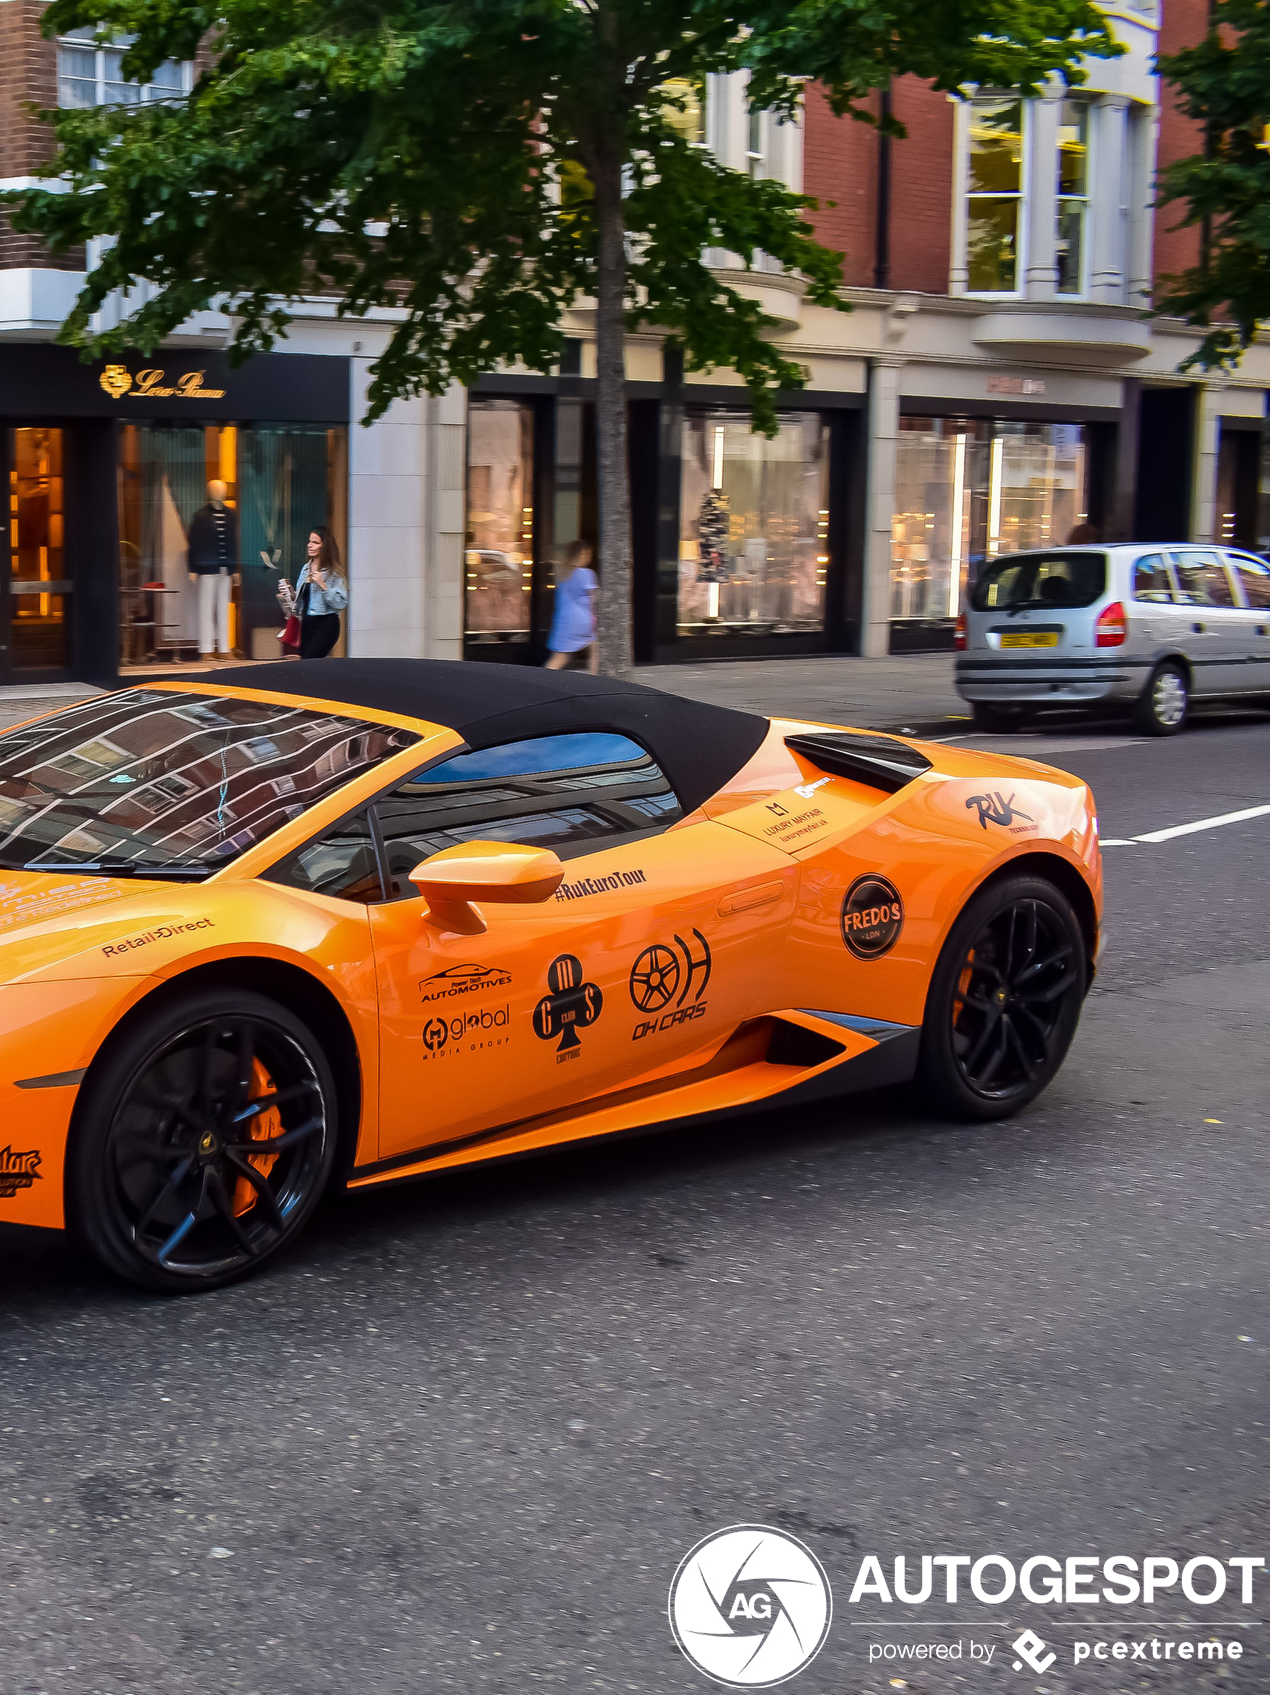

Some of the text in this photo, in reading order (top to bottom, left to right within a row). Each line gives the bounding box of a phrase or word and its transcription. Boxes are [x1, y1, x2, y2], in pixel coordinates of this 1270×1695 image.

[762, 808, 825, 837] LUXURY MAYFAIR
[555, 869, 647, 903] #RukEuroTour
[843, 902, 901, 933] FREDO'S
[420, 975, 513, 1004] AUTOMOTIVES
[658, 1000, 708, 1032] CARS
[422, 1037, 510, 1061] MEDIA GROUP
